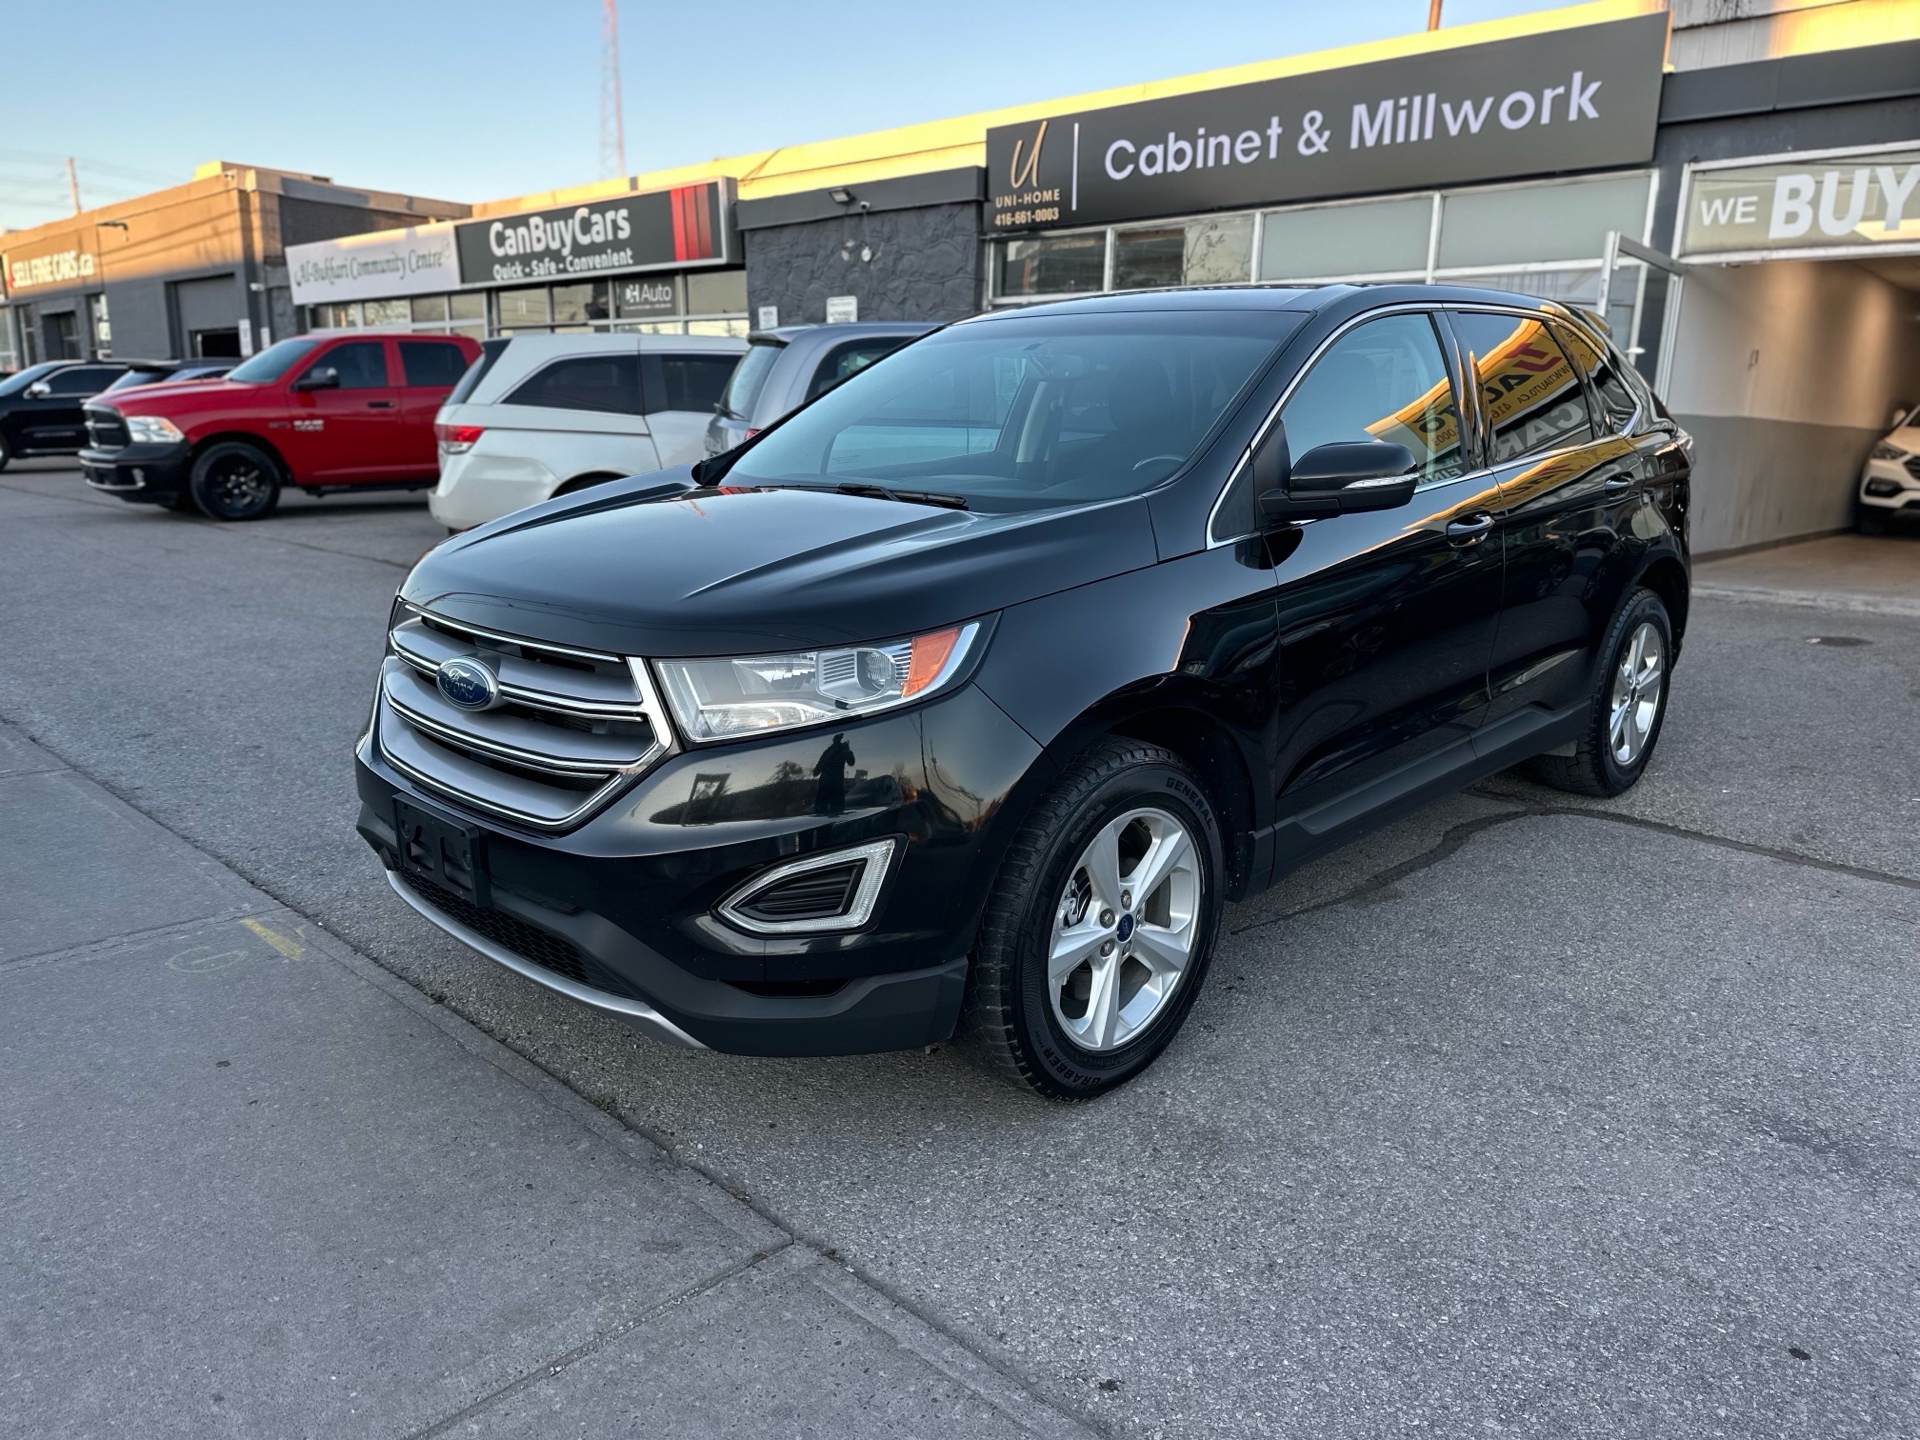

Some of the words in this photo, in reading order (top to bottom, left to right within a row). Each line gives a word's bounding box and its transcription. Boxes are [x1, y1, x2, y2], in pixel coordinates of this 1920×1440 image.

[1105, 116, 1282, 180] Cabinet
[1297, 110, 1331, 156] &
[1350, 71, 1602, 150] Millwork
[995, 189, 1061, 208] UNI-HOME
[995, 207, 1060, 226] 416-661-0003
[1701, 196, 1759, 226] WE
[1769, 164, 1920, 240] BUY
[489, 207, 631, 257] CanBuyCars
[350, 250, 406, 280] Community
[408, 249, 444, 273] Centre
[493, 261, 524, 281] Quick
[531, 257, 557, 276] Safe
[565, 247, 633, 272] Convenient
[641, 283, 672, 302] Auto
[1165, 776, 1213, 831] GENERAL
[1043, 1047, 1102, 1087] GRABBER
